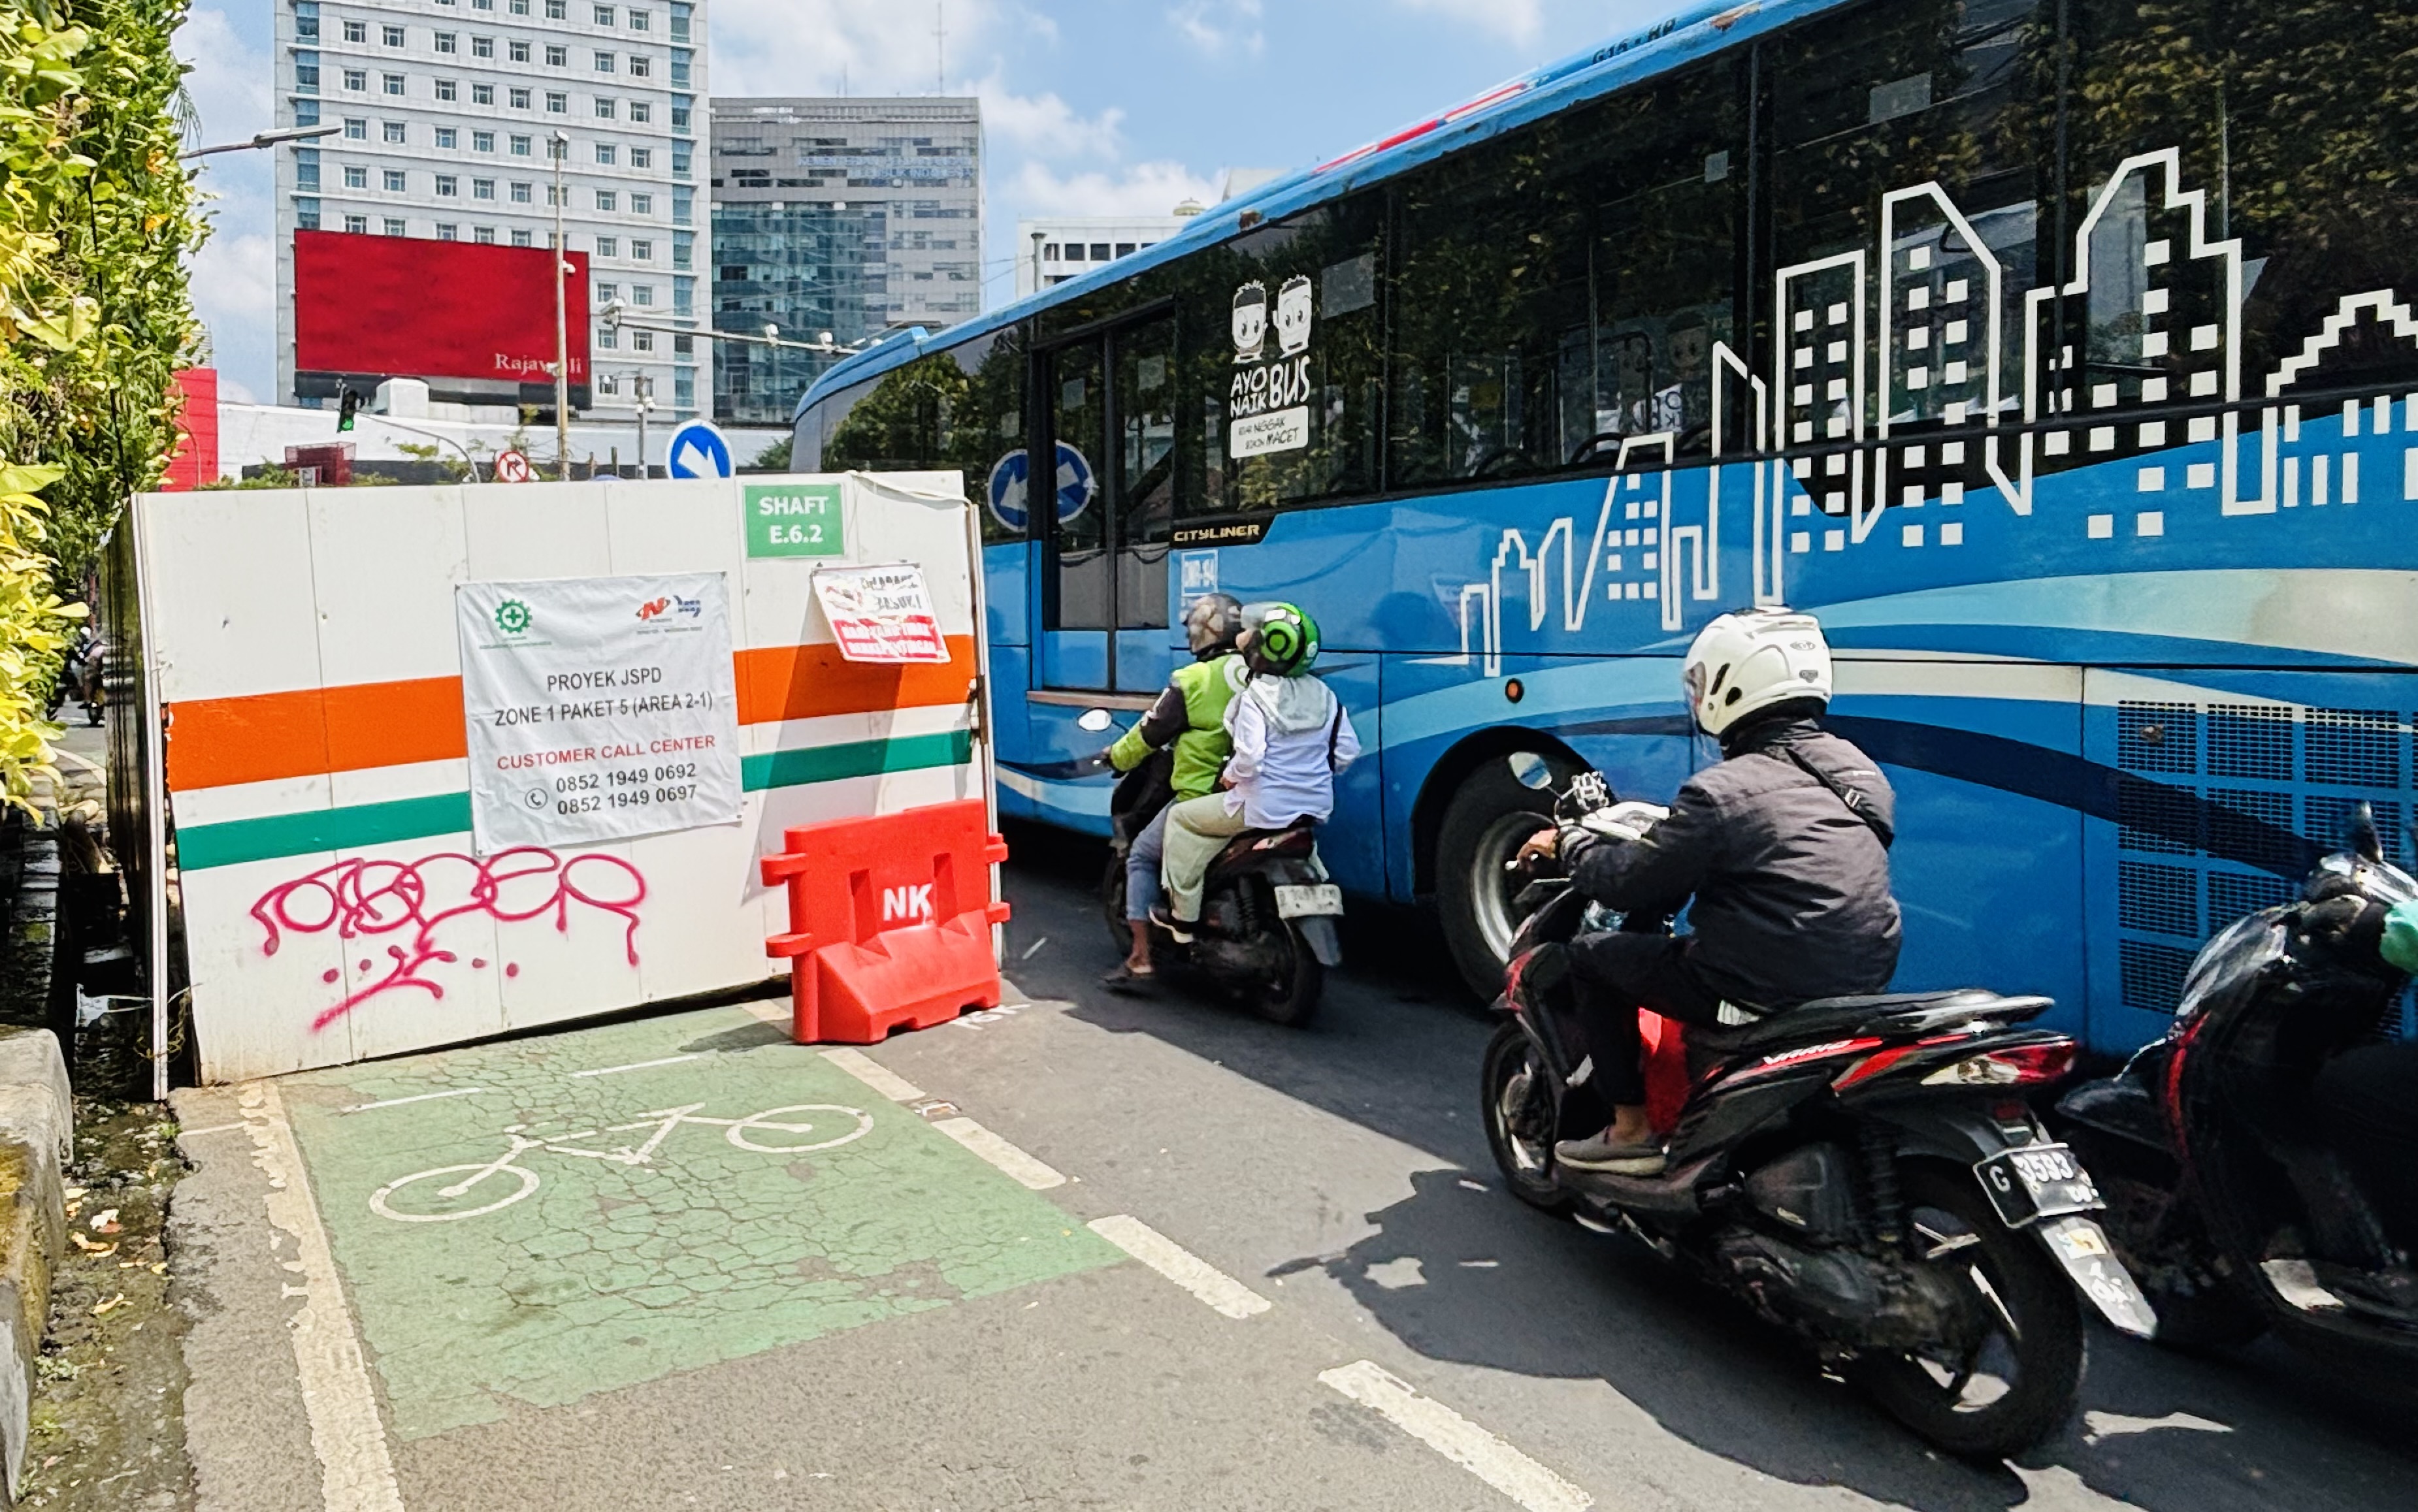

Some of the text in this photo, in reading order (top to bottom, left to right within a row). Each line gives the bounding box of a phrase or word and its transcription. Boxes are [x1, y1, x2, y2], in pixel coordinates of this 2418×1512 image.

[495, 353, 582, 376] Rajawli
[1230, 366, 1267, 398] AYO
[1230, 355, 1311, 418] NAIK BUS
[1266, 426, 1299, 446] MACET
[759, 496, 829, 515] SHAFT
[770, 524, 823, 544] E.6.2
[1173, 524, 1260, 541] CITYLINER
[547, 666, 662, 692] PROYEK JSPD
[495, 691, 713, 726] ZONE 1 PAKET 5 (AREA 2-1)
[497, 735, 716, 771] CUSTOMER CALL CENTER
[556, 762, 697, 793] 0852 1949 0692
[557, 784, 697, 815] 0852 1949 0697
[883, 883, 934, 921] NK
[1989, 1165, 2010, 1192] G
